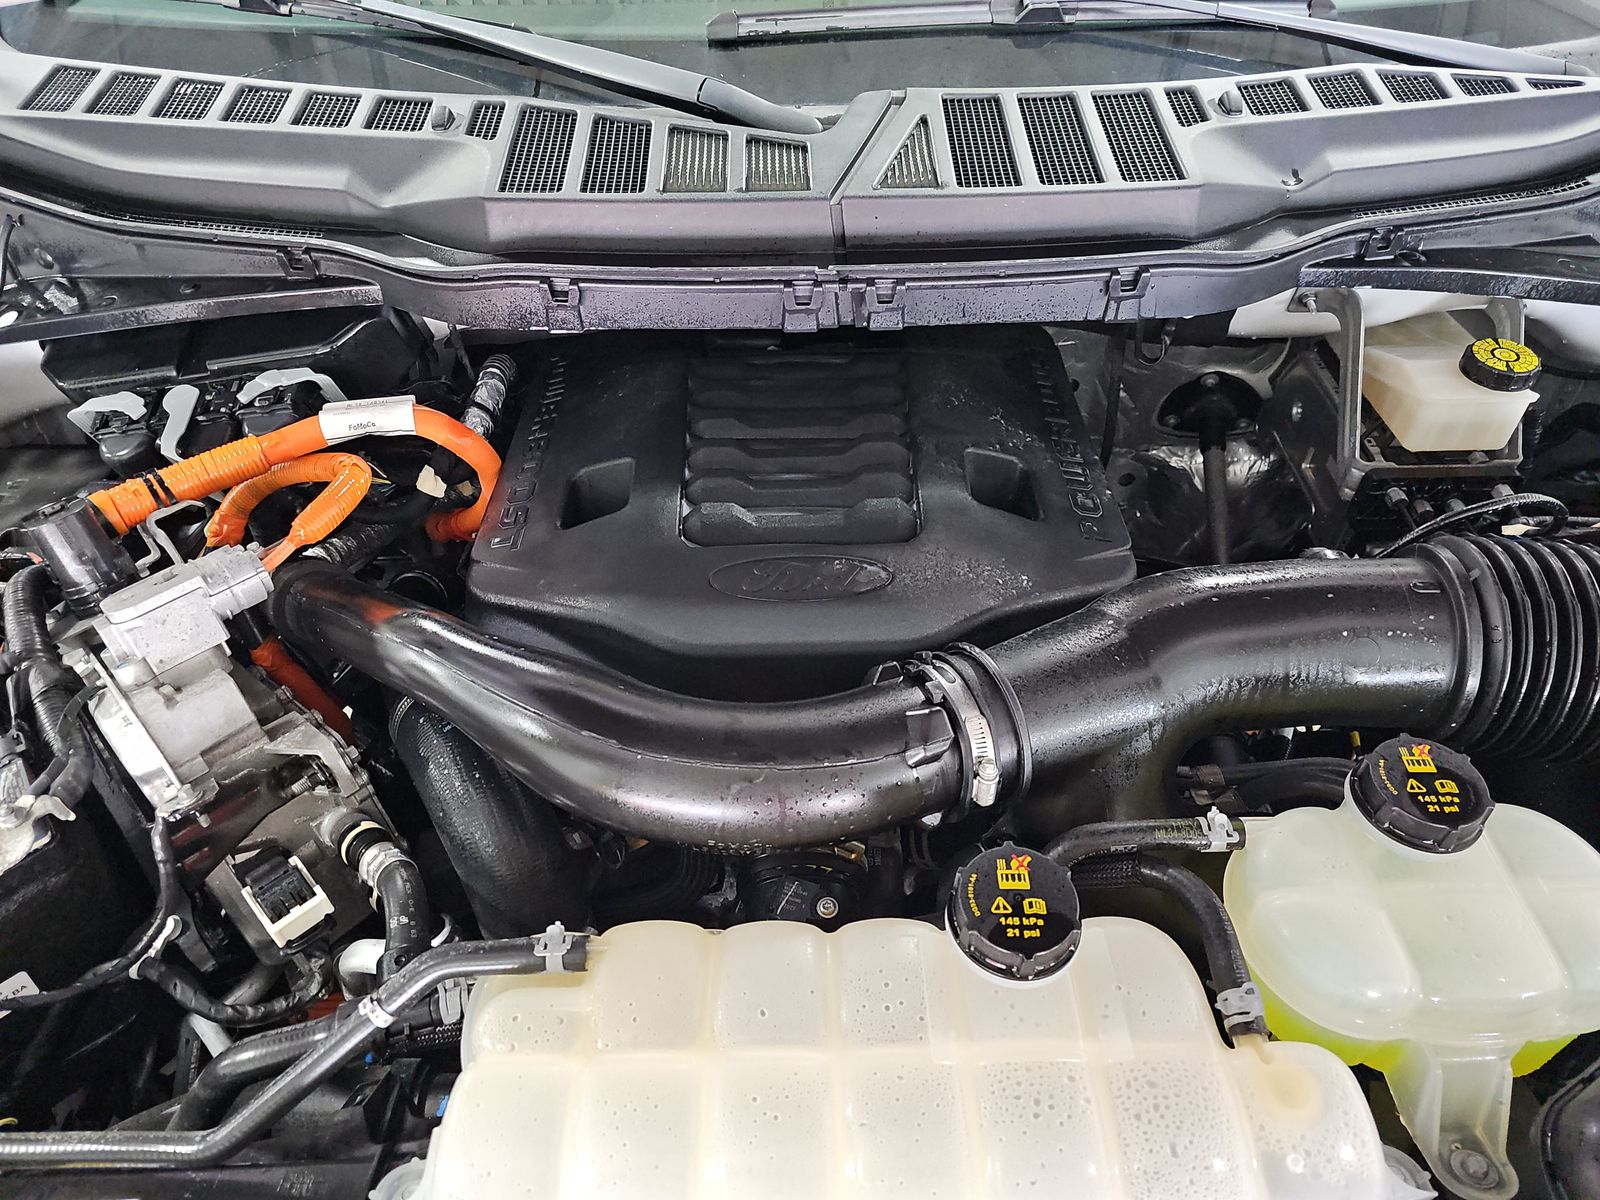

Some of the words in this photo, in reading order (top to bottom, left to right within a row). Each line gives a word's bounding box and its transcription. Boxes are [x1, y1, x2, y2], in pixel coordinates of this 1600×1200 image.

[348, 421, 376, 432] FoMoCo
[1417, 794, 1437, 803] 145
[1438, 794, 1460, 803] kPa
[1426, 804, 1441, 813] 21
[1443, 805, 1460, 814] psi
[1000, 916, 1021, 926] 145
[1022, 916, 1045, 926] kPa
[1006, 928, 1020, 938] 21
[1023, 928, 1041, 939] psi
